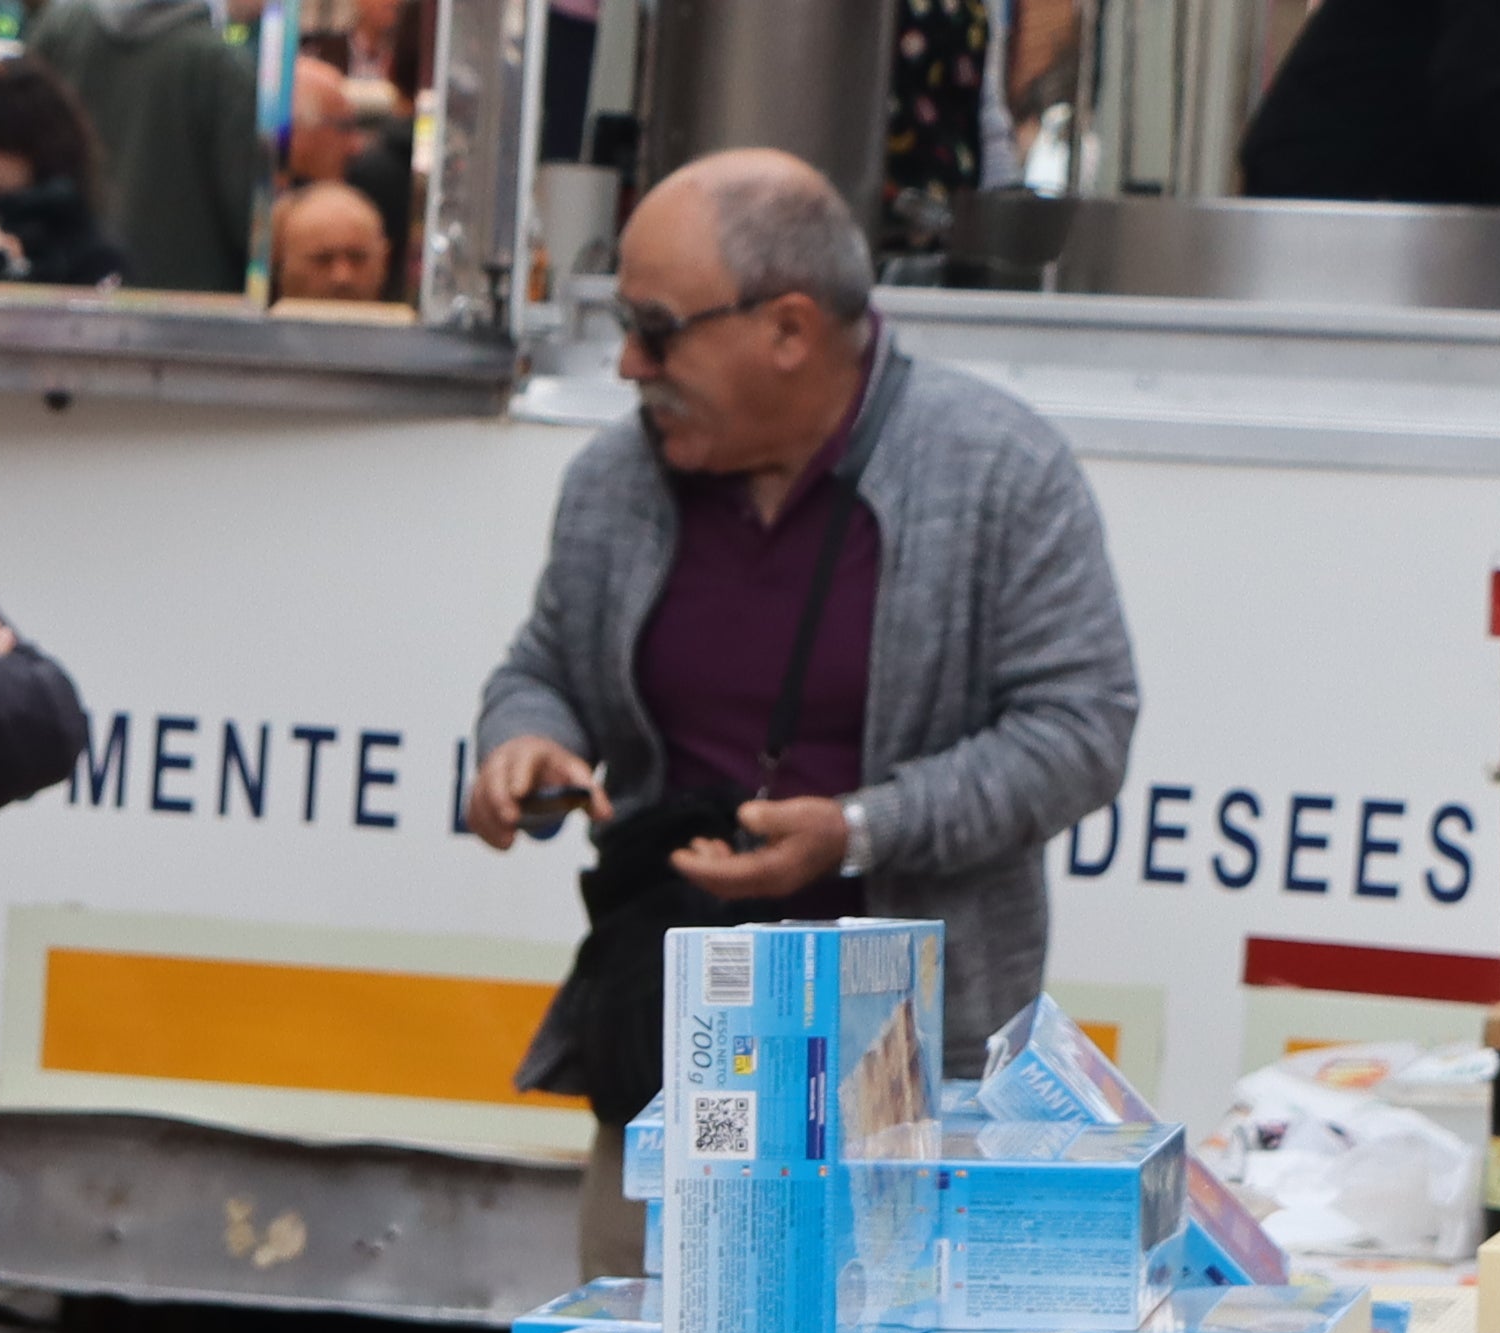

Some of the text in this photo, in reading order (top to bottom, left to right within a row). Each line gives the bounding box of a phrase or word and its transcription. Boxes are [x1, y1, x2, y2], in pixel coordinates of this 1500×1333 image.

[69, 711, 402, 829] MENTE
[1068, 785, 1476, 904] DESEES
[692, 1014, 713, 1069] 700
[716, 1011, 728, 1046] PESO
